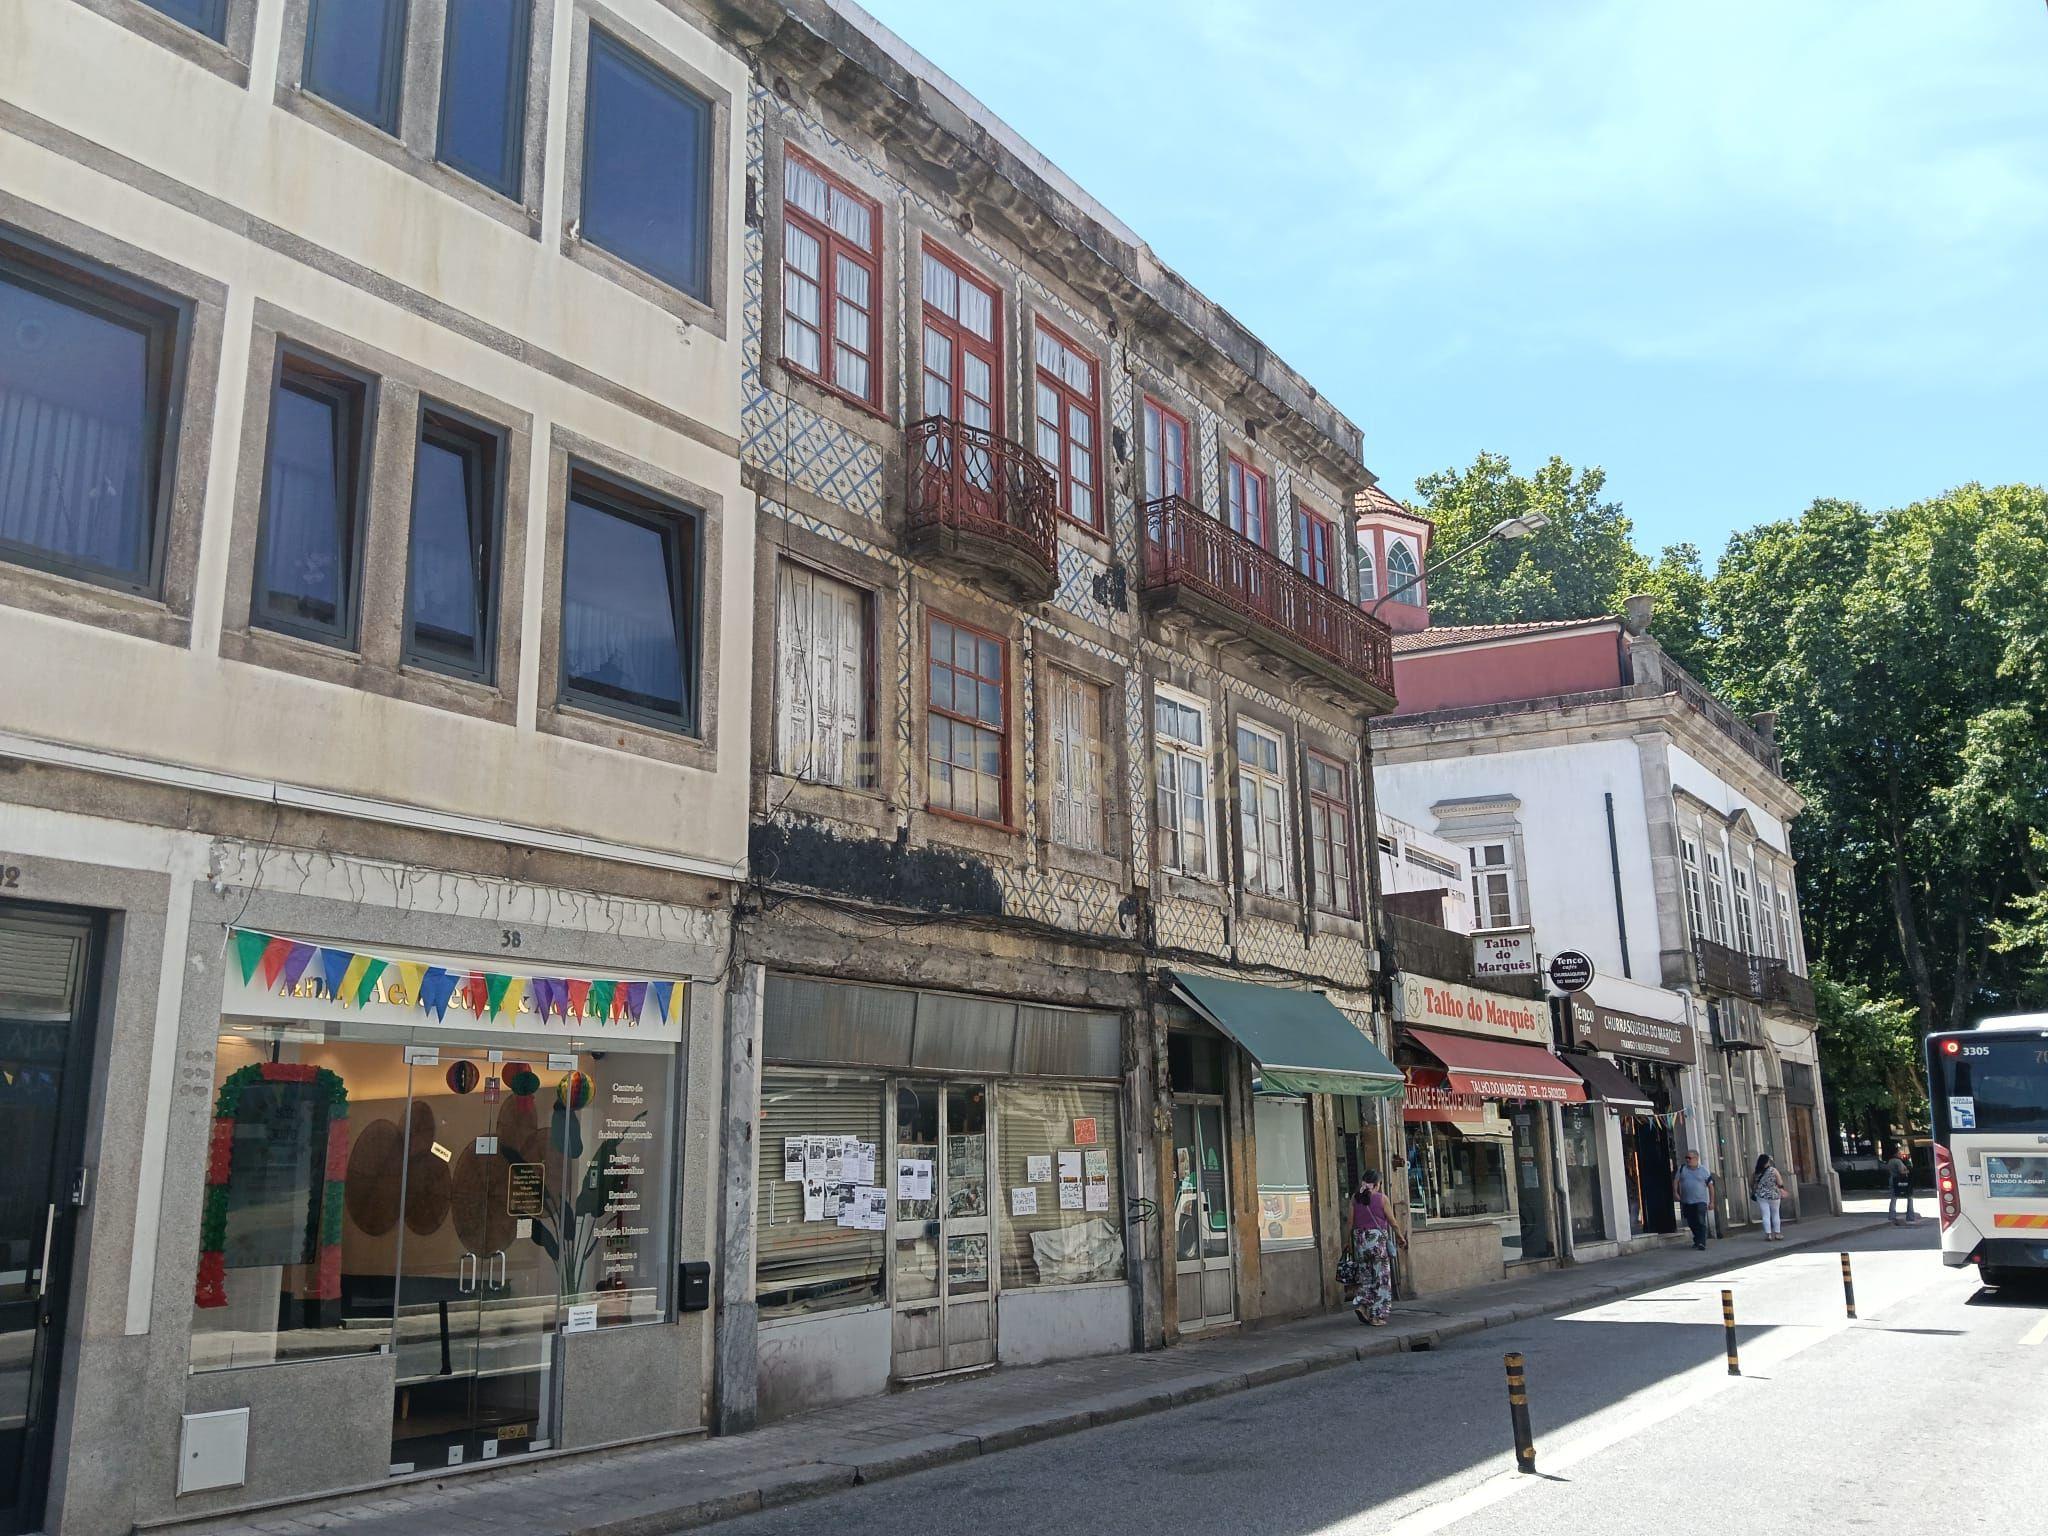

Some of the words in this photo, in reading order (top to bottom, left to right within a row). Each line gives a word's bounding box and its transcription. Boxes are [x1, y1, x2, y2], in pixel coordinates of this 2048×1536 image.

[501, 929, 521, 948] 38
[1484, 938, 1520, 949] Talho
[1495, 950, 1511, 960] do
[1477, 960, 1532, 972] Marquês
[1556, 957, 1583, 965] Tenco
[1424, 987, 1464, 1018] Talho
[1467, 996, 1483, 1022] do
[1485, 999, 1536, 1034] Marquês
[1573, 1001, 1595, 1023] Tenco
[1604, 1015, 1650, 1037] CHURRASQUEIRA
[1650, 1024, 1658, 1038] DO
[1658, 1026, 1682, 1044] MARQUÊS
[1962, 1046, 1990, 1056] 3305
[612, 1083, 634, 1092] Centro
[635, 1083, 643, 1092] de
[1470, 1080, 1491, 1093] TALHO
[1491, 1081, 1500, 1094] DO
[1500, 1081, 1527, 1096] MARQUÊS
[612, 1095, 643, 1105] Formação
[609, 1154, 631, 1164] Design
[632, 1154, 640, 1162] de
[604, 1203, 613, 1211] de
